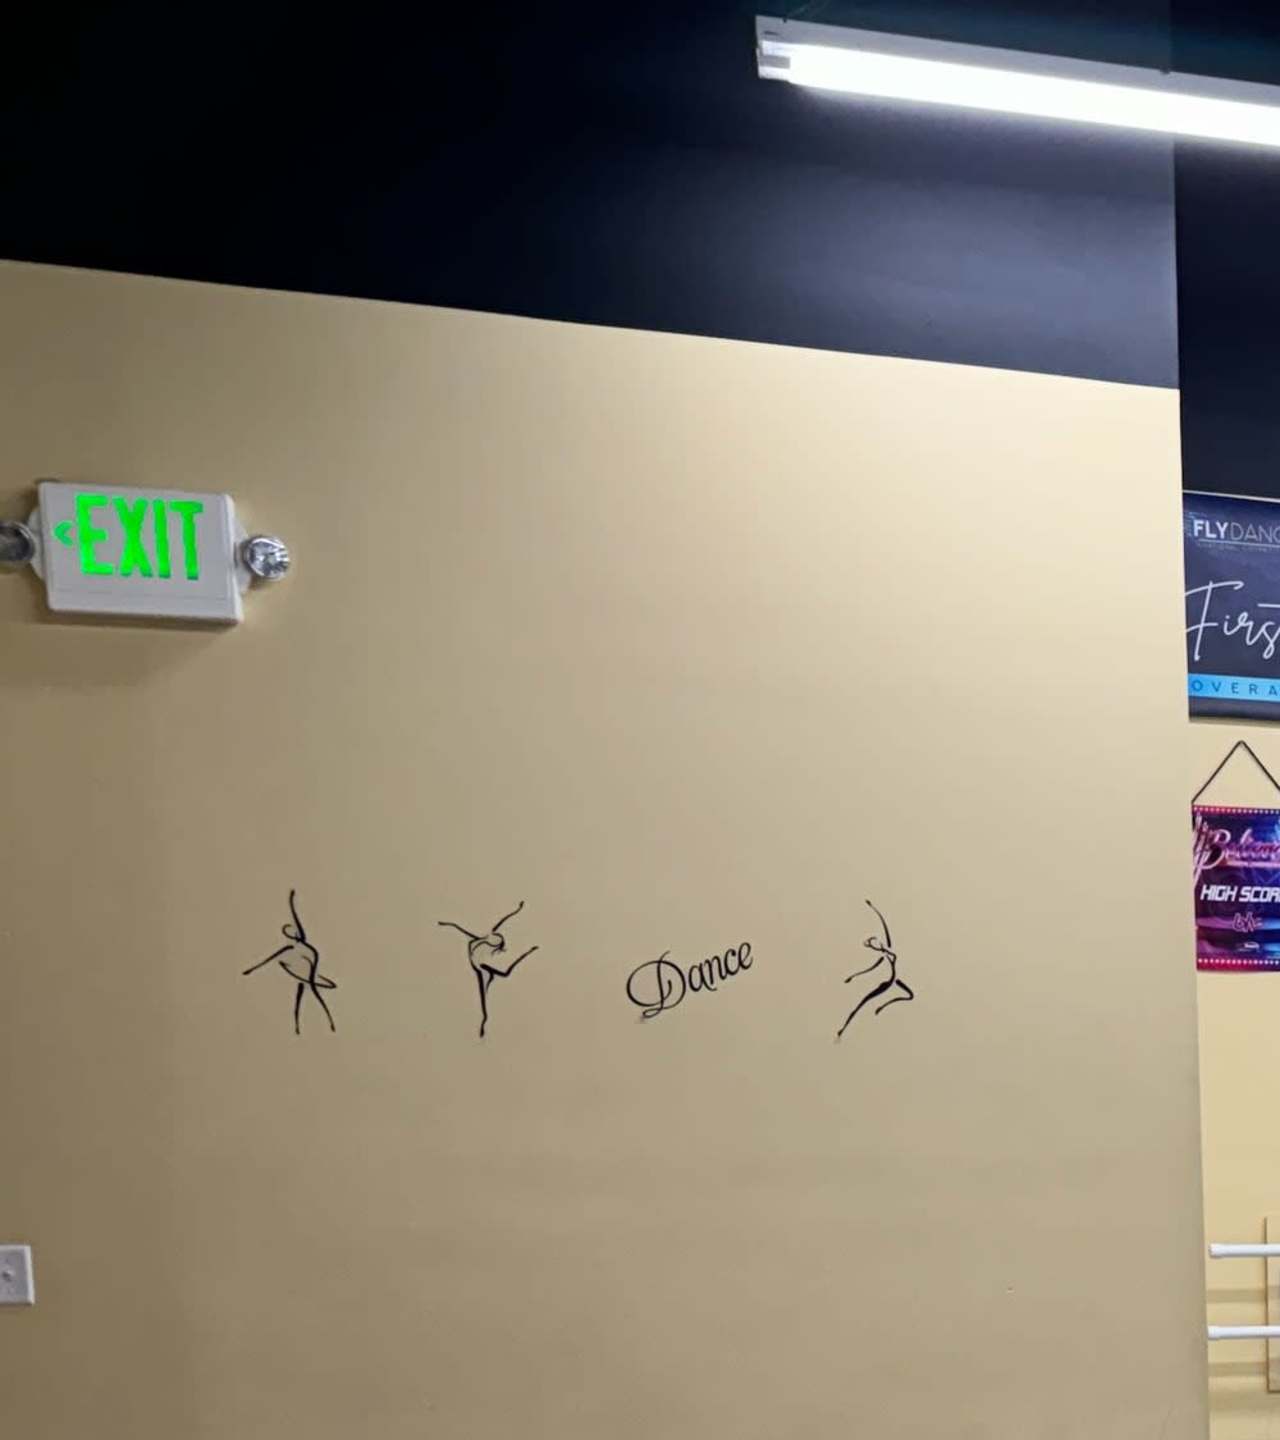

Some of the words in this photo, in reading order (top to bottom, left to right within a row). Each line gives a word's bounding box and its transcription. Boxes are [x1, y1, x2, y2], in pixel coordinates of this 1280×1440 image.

[75, 493, 203, 581] EXIT
[1200, 884, 1239, 902] HIGH
[626, 942, 753, 1018] Dance
